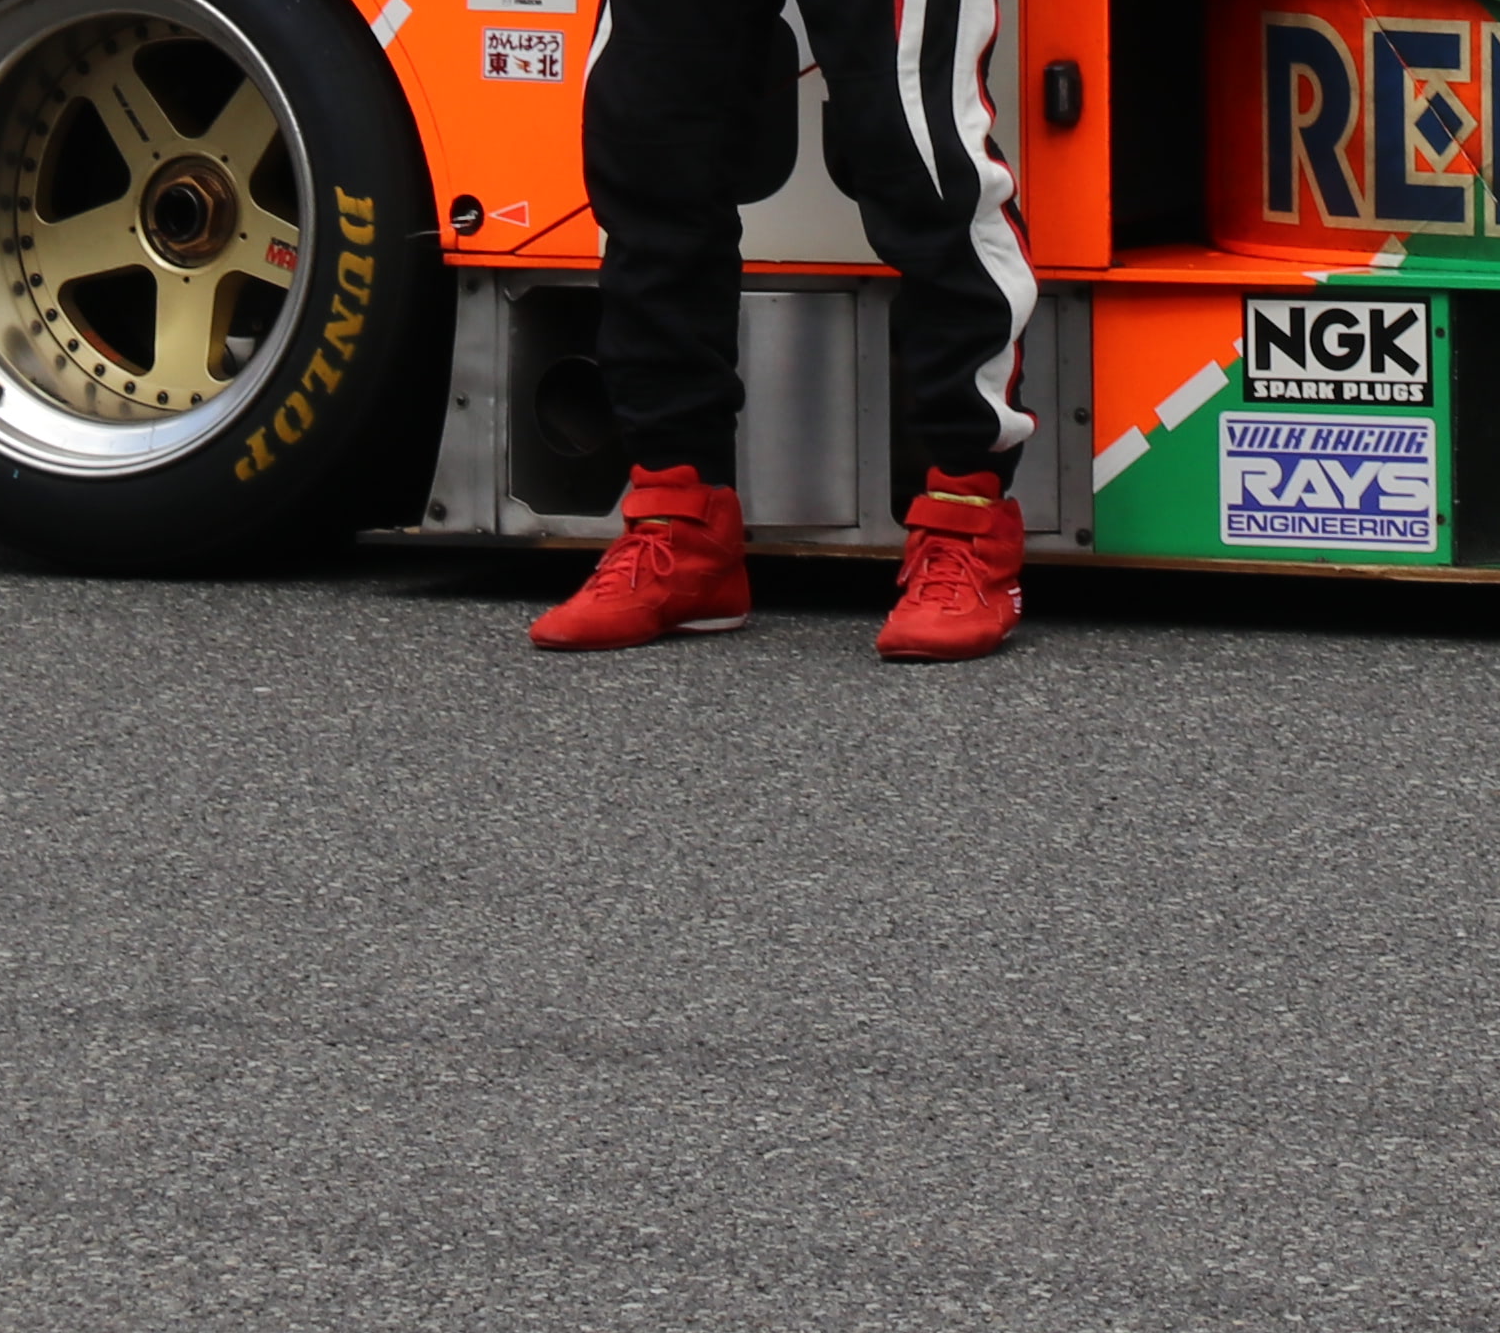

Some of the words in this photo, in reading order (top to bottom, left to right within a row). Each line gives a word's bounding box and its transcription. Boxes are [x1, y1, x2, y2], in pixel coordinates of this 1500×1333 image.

[487, 33, 561, 53] がんばろう
[488, 52, 510, 75] 東
[537, 55, 559, 78] 北
[234, 186, 376, 481] DUNLOP
[1254, 306, 1421, 377] NGK
[1252, 380, 1337, 401] SPARK
[1342, 381, 1425, 403] PLUGS
[1226, 425, 1307, 451] VOLK
[1309, 427, 1428, 455] RACING
[1224, 456, 1430, 513] RAYS
[1227, 513, 1430, 538] ENGINEERING
